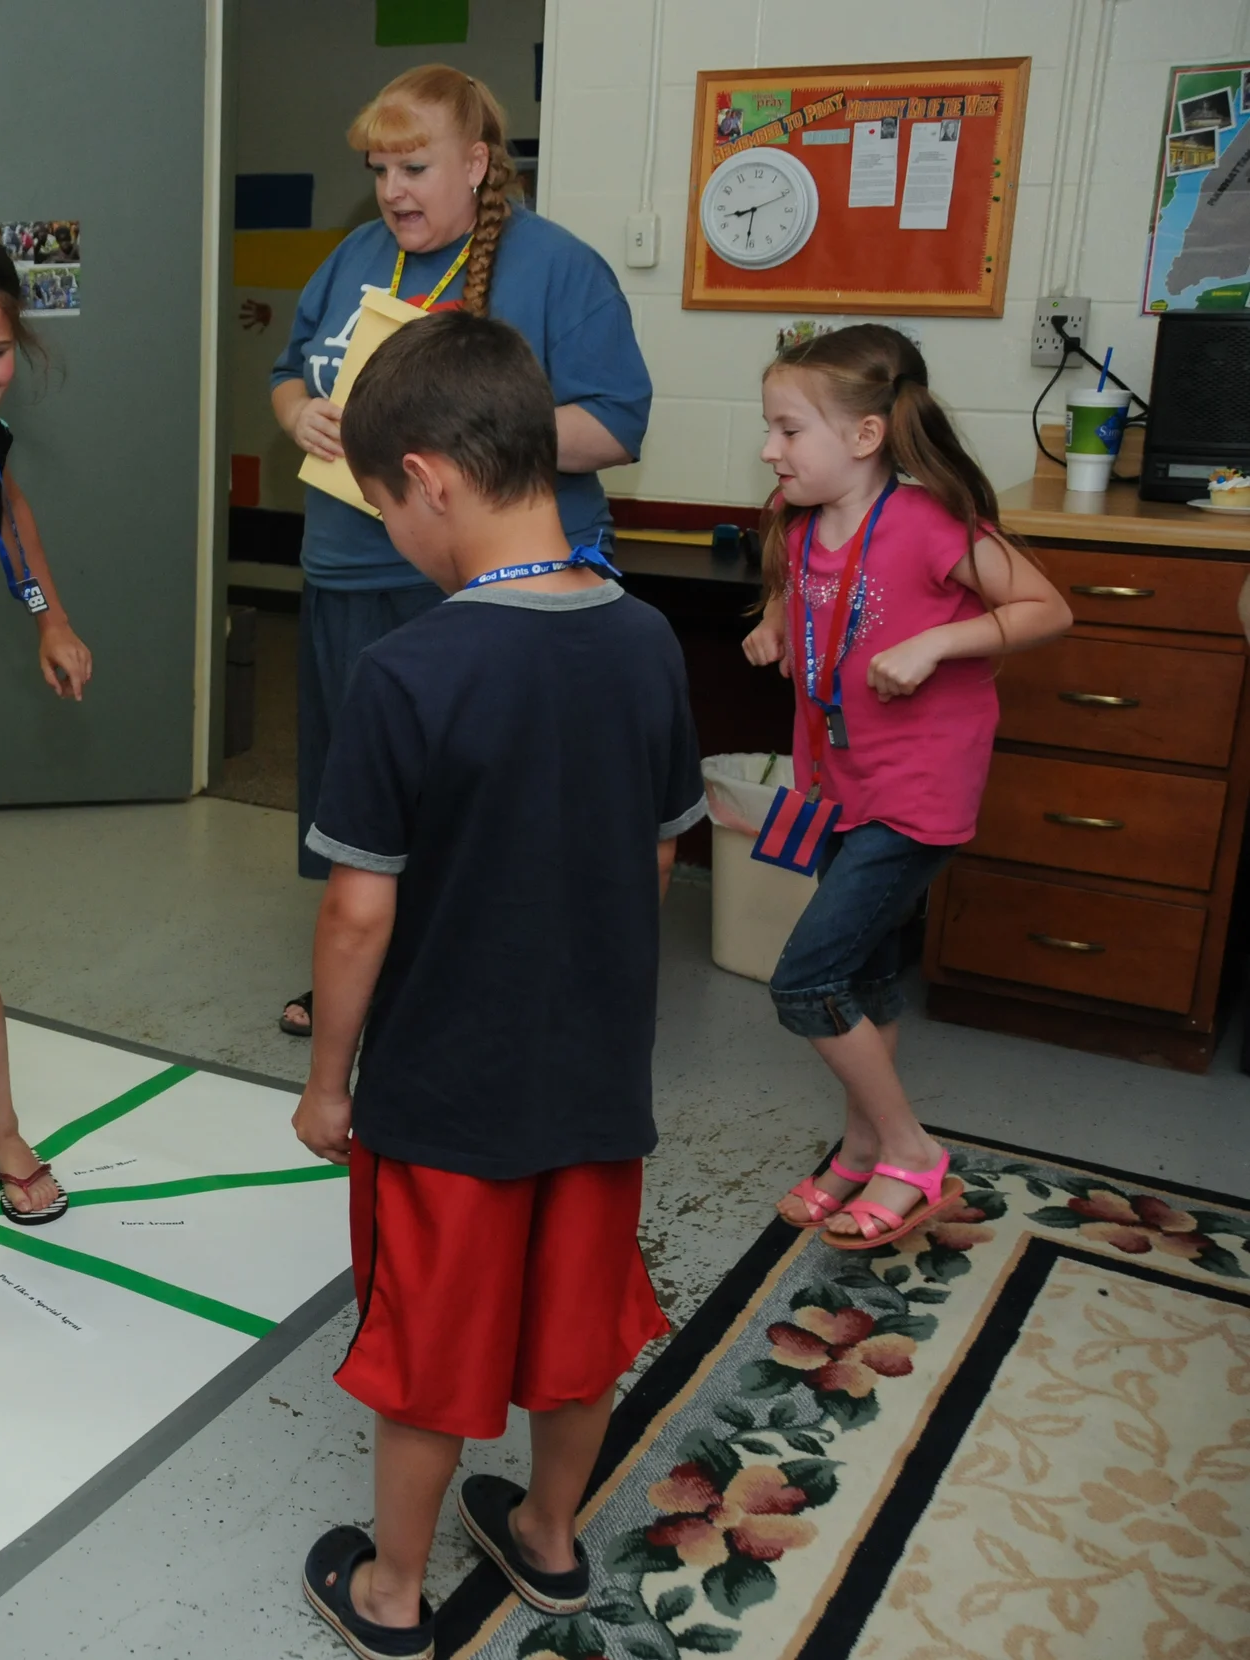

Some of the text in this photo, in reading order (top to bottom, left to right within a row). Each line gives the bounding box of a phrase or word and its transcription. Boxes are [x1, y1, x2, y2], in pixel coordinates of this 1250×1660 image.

[757, 98, 784, 111] pray
[845, 95, 998, 120] MISSIONARY KID OF THE WEEK
[712, 121, 784, 165] REMEMBER
[783, 112, 803, 132] TO
[803, 92, 845, 123] PRAY
[479, 573, 497, 583] God
[500, 566, 529, 579] Lights
[532, 564, 550, 574] Our
[13, 1284, 30, 1296] Like
[34, 1299, 62, 1317] Special
[60, 1316, 82, 1331] Agent
